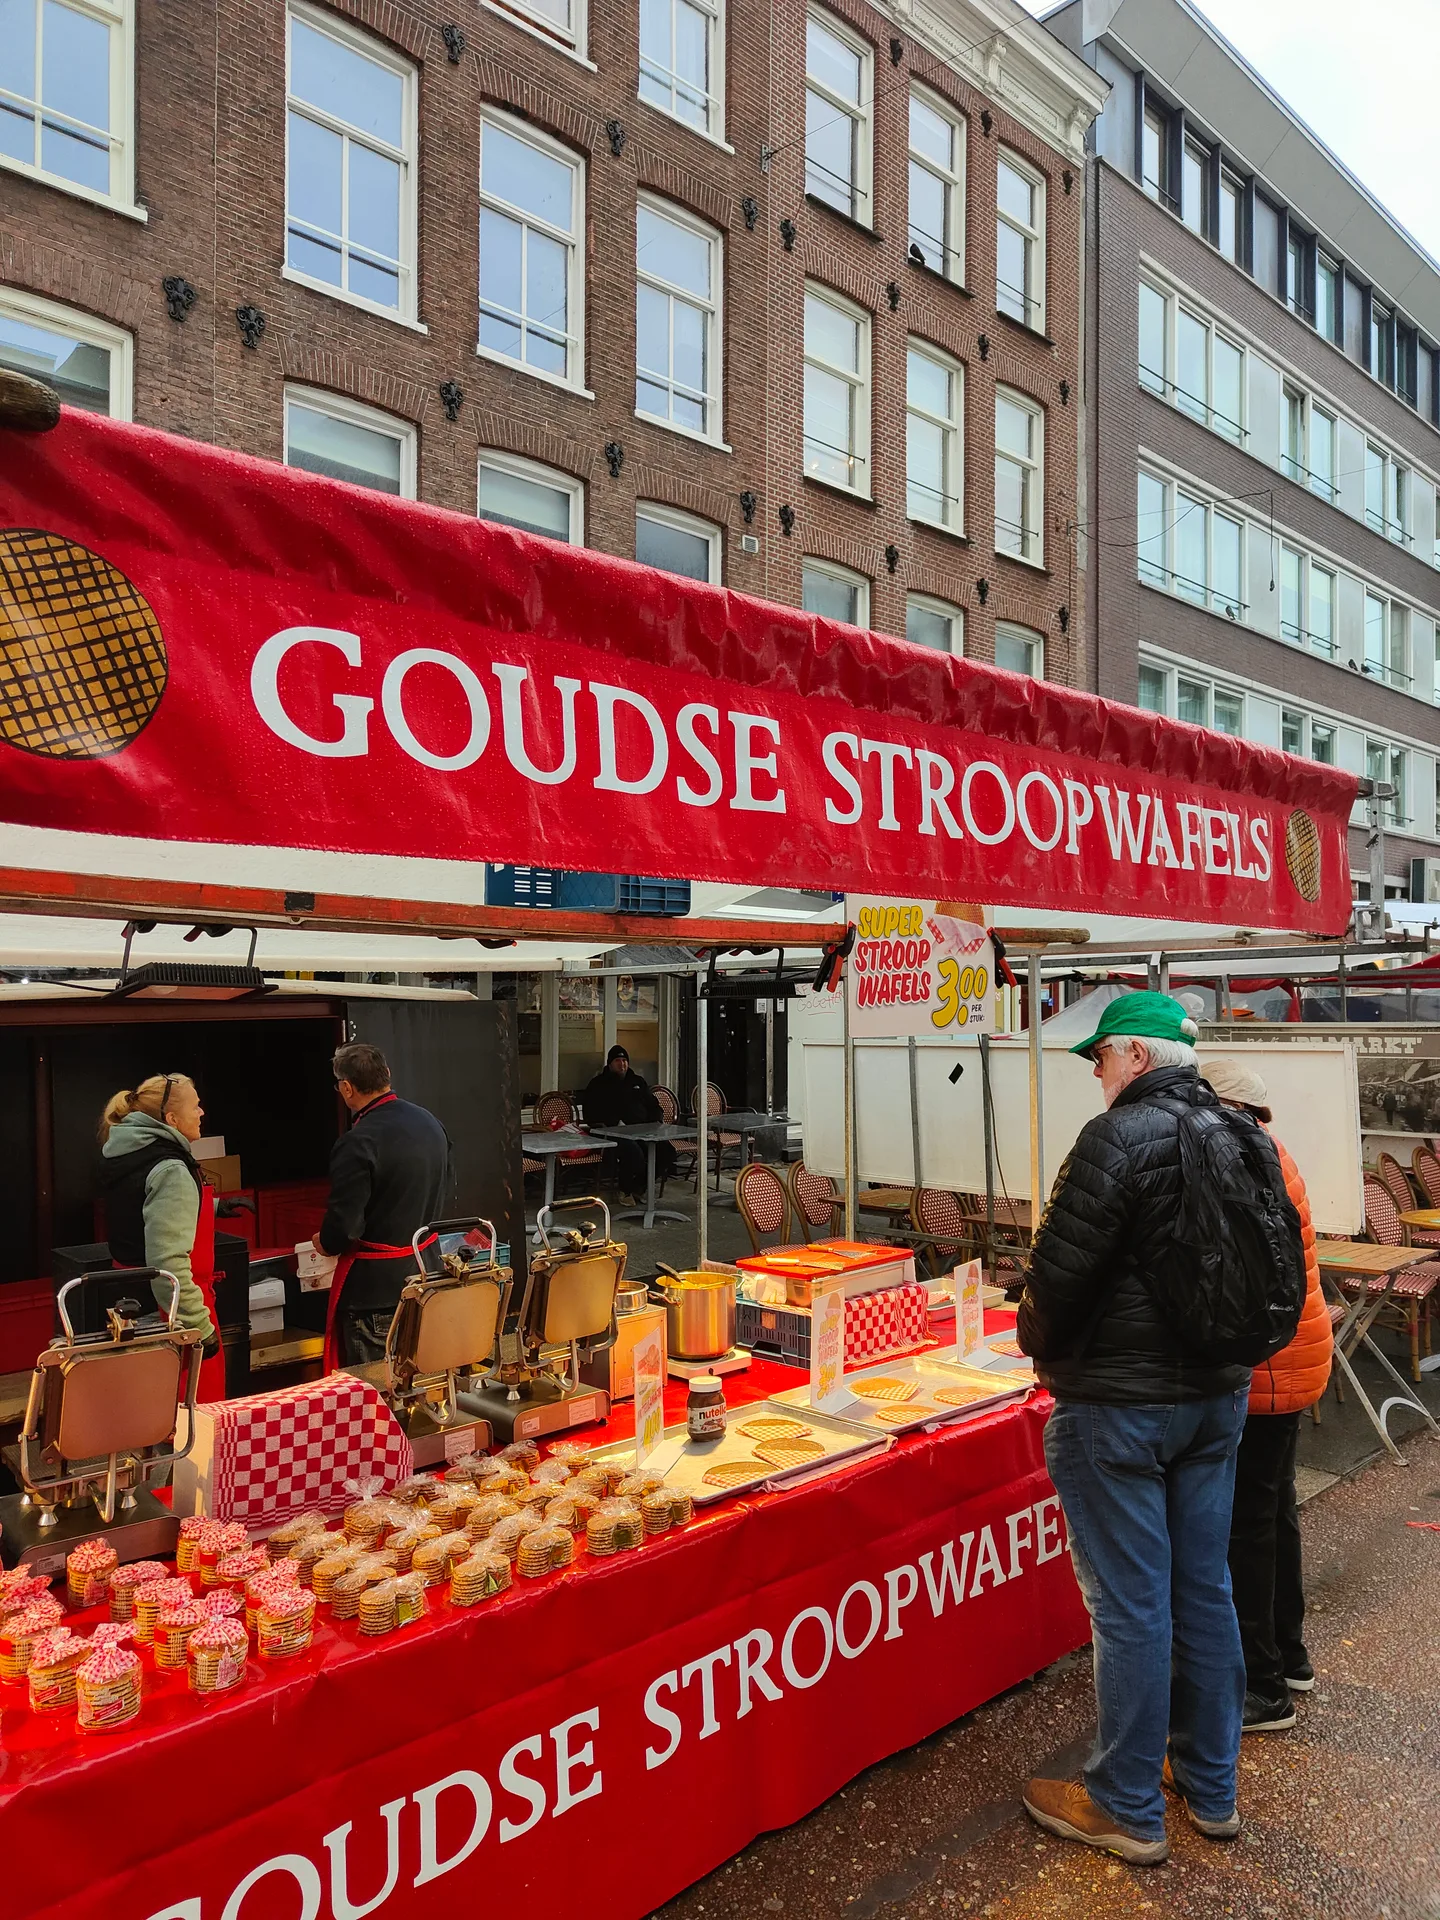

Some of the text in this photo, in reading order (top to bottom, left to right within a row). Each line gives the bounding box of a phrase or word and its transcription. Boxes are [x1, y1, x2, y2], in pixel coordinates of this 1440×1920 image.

[250, 626, 1272, 882] GOUDSE STROOPWAFELS
[858, 905, 923, 938] SUPER
[855, 939, 931, 973] STROOP
[857, 971, 931, 1007] WAFELS
[971, 1003, 982, 1012] PER
[146, 1493, 1071, 1920] OUDSE STROOPWAFE
